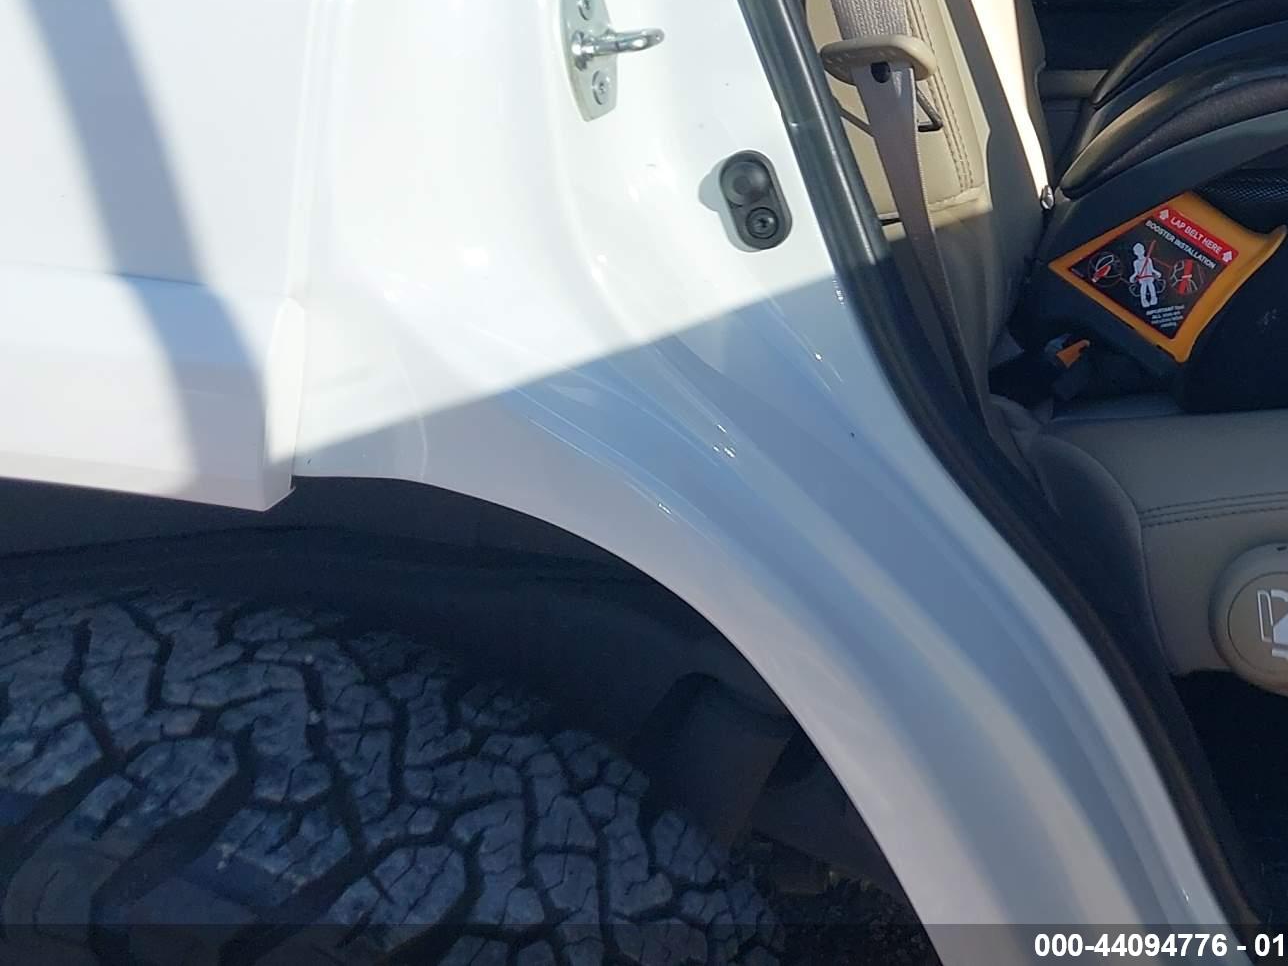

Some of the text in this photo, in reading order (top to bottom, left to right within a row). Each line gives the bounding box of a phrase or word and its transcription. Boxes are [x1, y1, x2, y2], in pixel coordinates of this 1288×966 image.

[1145, 219, 1217, 269] BOOSTER INSTALLATION
[1170, 216, 1223, 255] LAP BELT HERE
